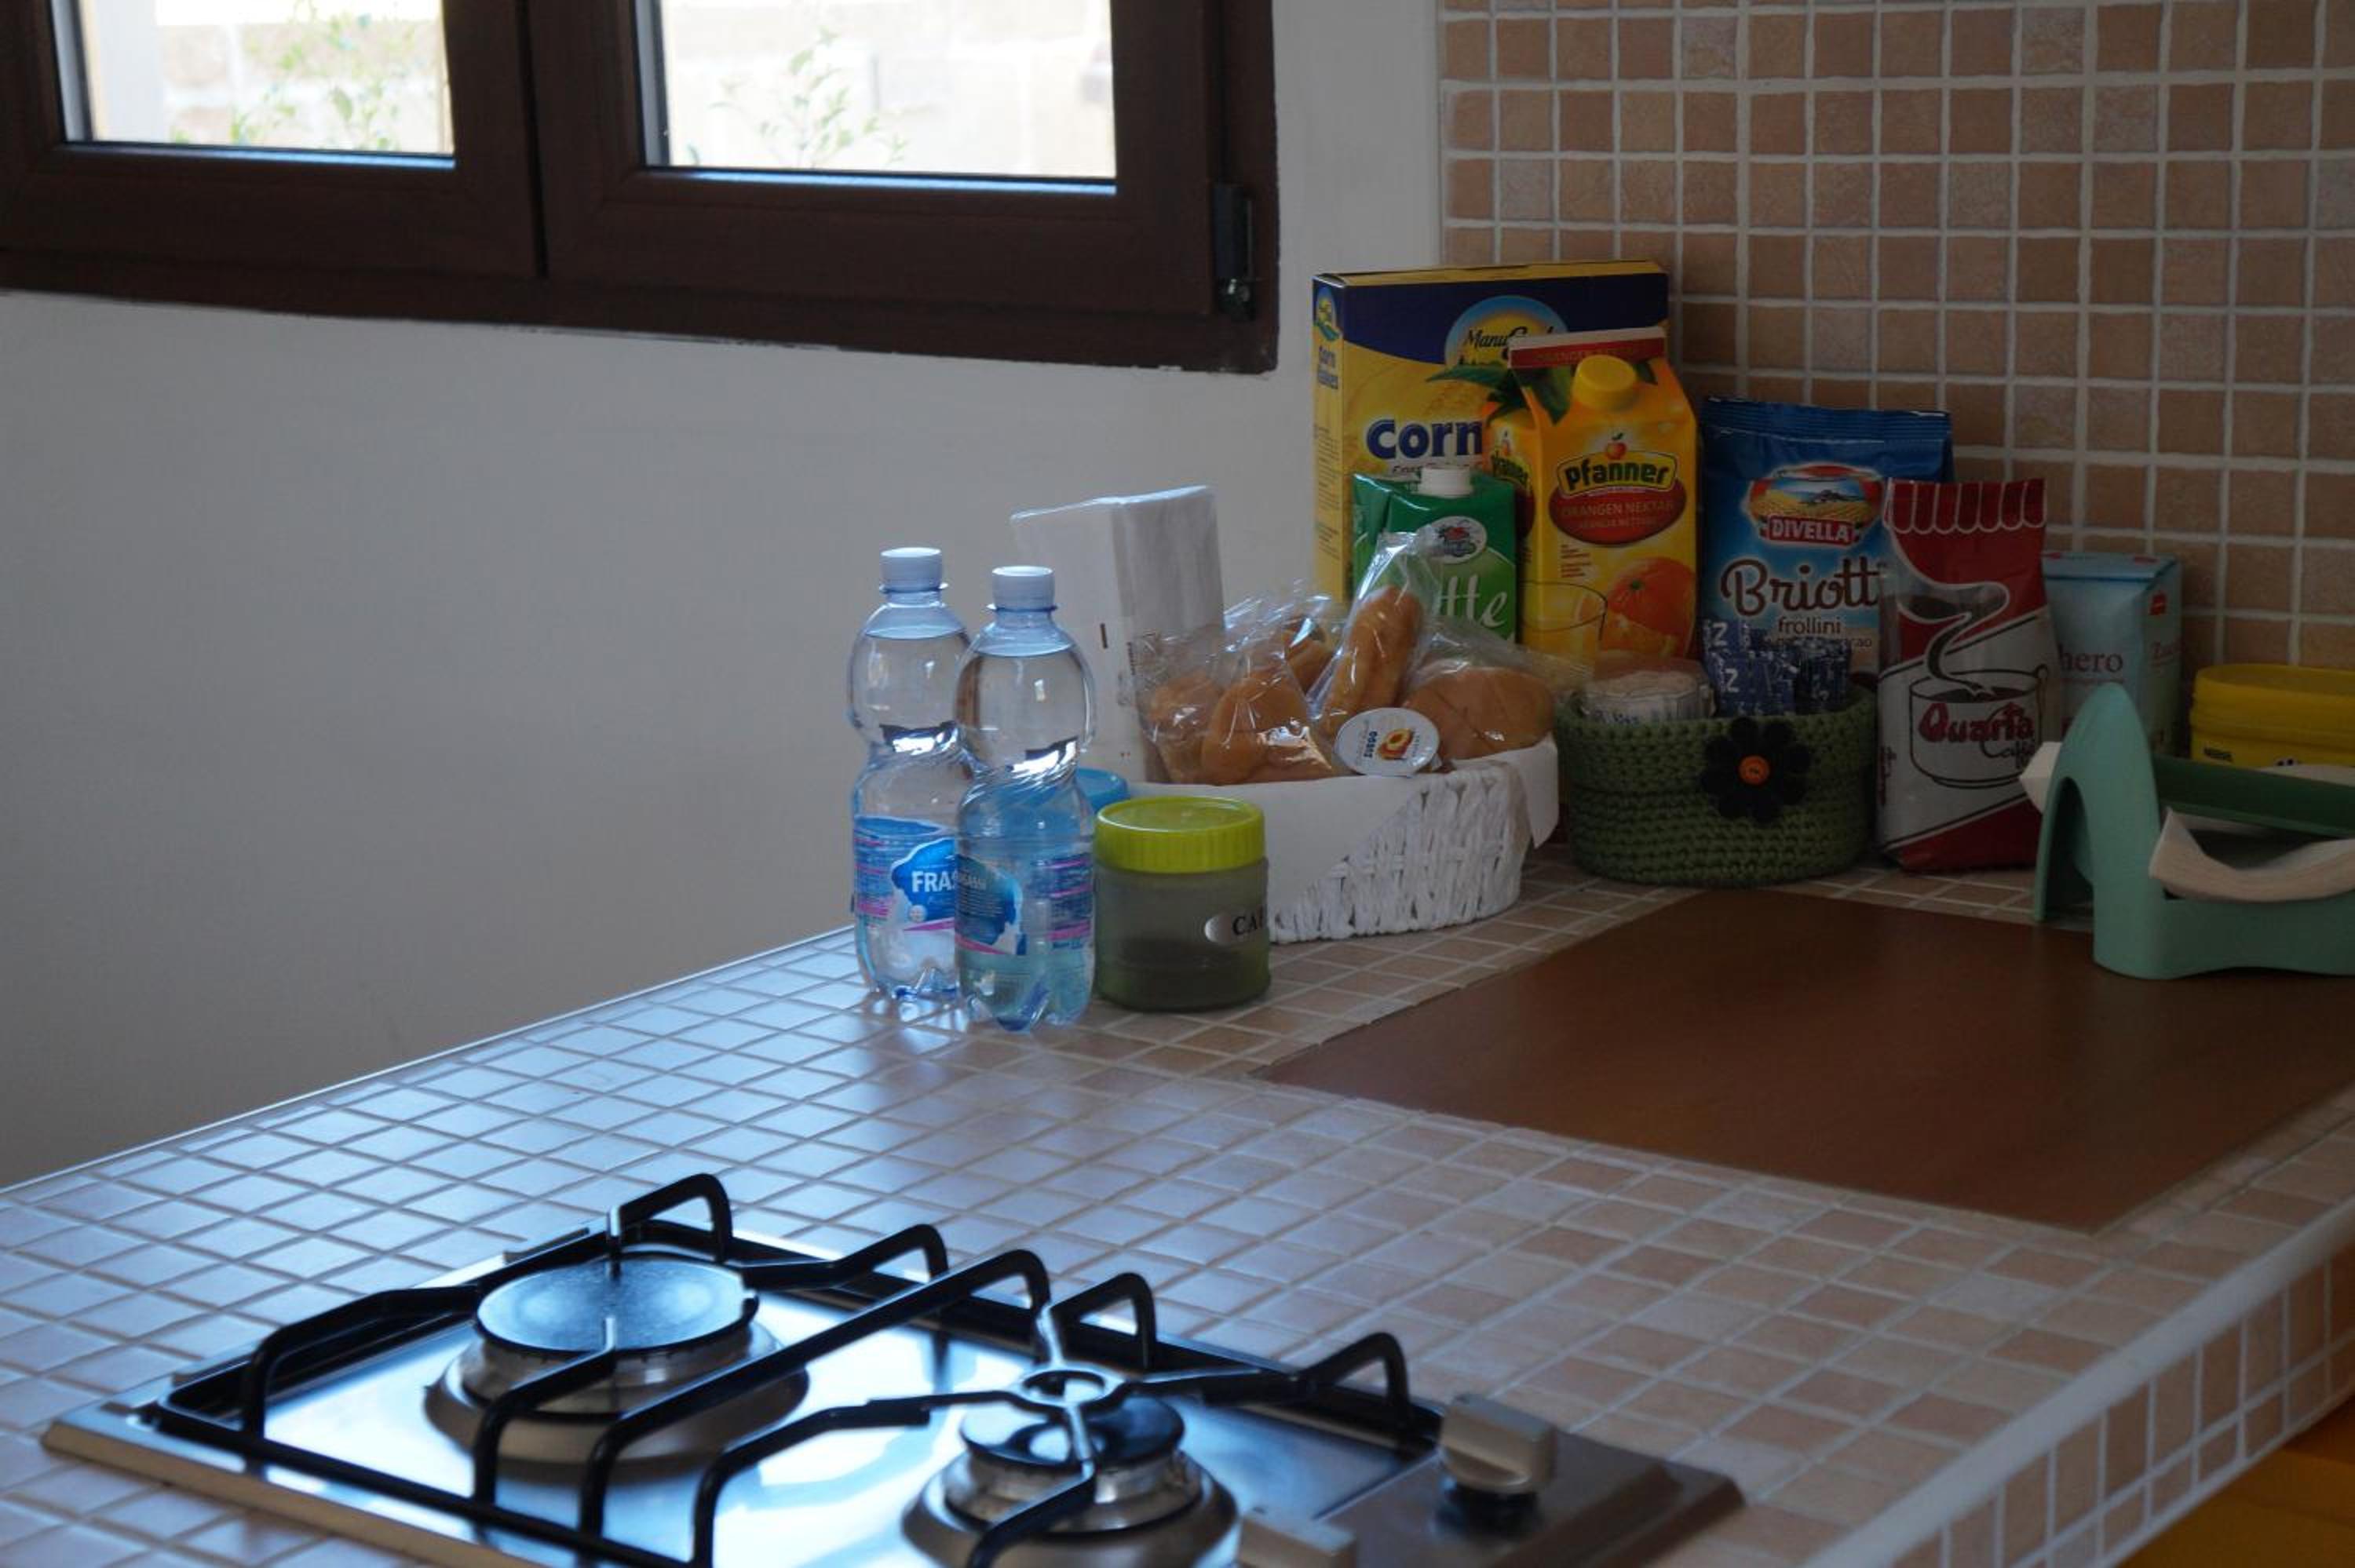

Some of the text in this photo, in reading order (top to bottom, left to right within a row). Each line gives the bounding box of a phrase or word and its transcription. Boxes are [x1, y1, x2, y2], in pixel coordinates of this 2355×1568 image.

[1367, 419, 1483, 458] Corn
[1565, 457, 1669, 490] pfanner
[1772, 518, 1848, 541] DIVELLA
[1721, 556, 1883, 616] Briott
[1779, 616, 1841, 634] frollini
[2058, 644, 2123, 673] hero
[1919, 702, 2034, 742] Quarta
